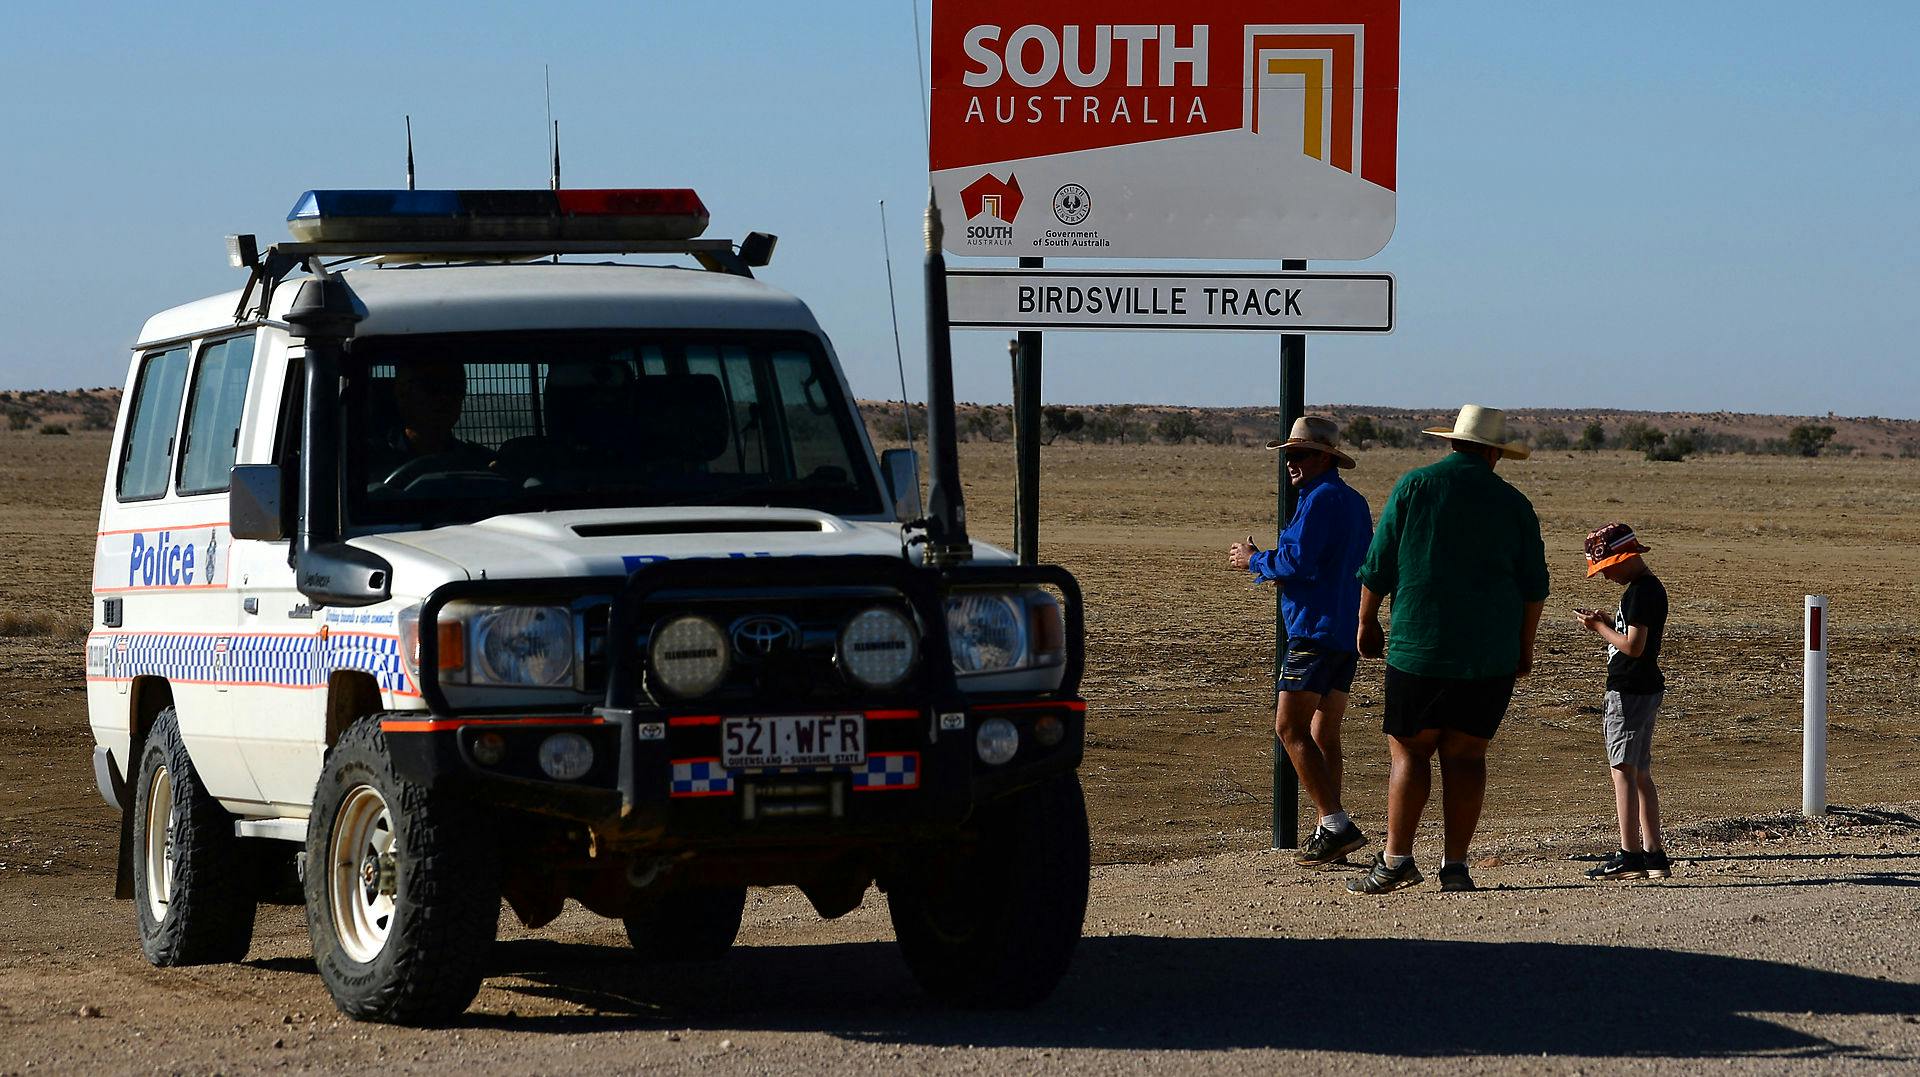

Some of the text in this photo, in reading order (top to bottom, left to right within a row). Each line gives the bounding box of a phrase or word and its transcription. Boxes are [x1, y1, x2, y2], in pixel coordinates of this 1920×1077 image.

[963, 24, 1209, 88] SOUTH
[964, 95, 1207, 123] AUSTRALIA
[967, 226, 1013, 239] SOUTH
[1033, 238, 1110, 247] of South Australia
[1045, 230, 1098, 238] Government
[1018, 286, 1302, 316] BIRDSVILLE TRACK
[129, 531, 195, 587] Police
[729, 756, 782, 766] QUEENSLAND
[791, 755, 830, 765] SUNSHINE
[835, 754, 858, 764] STATE
